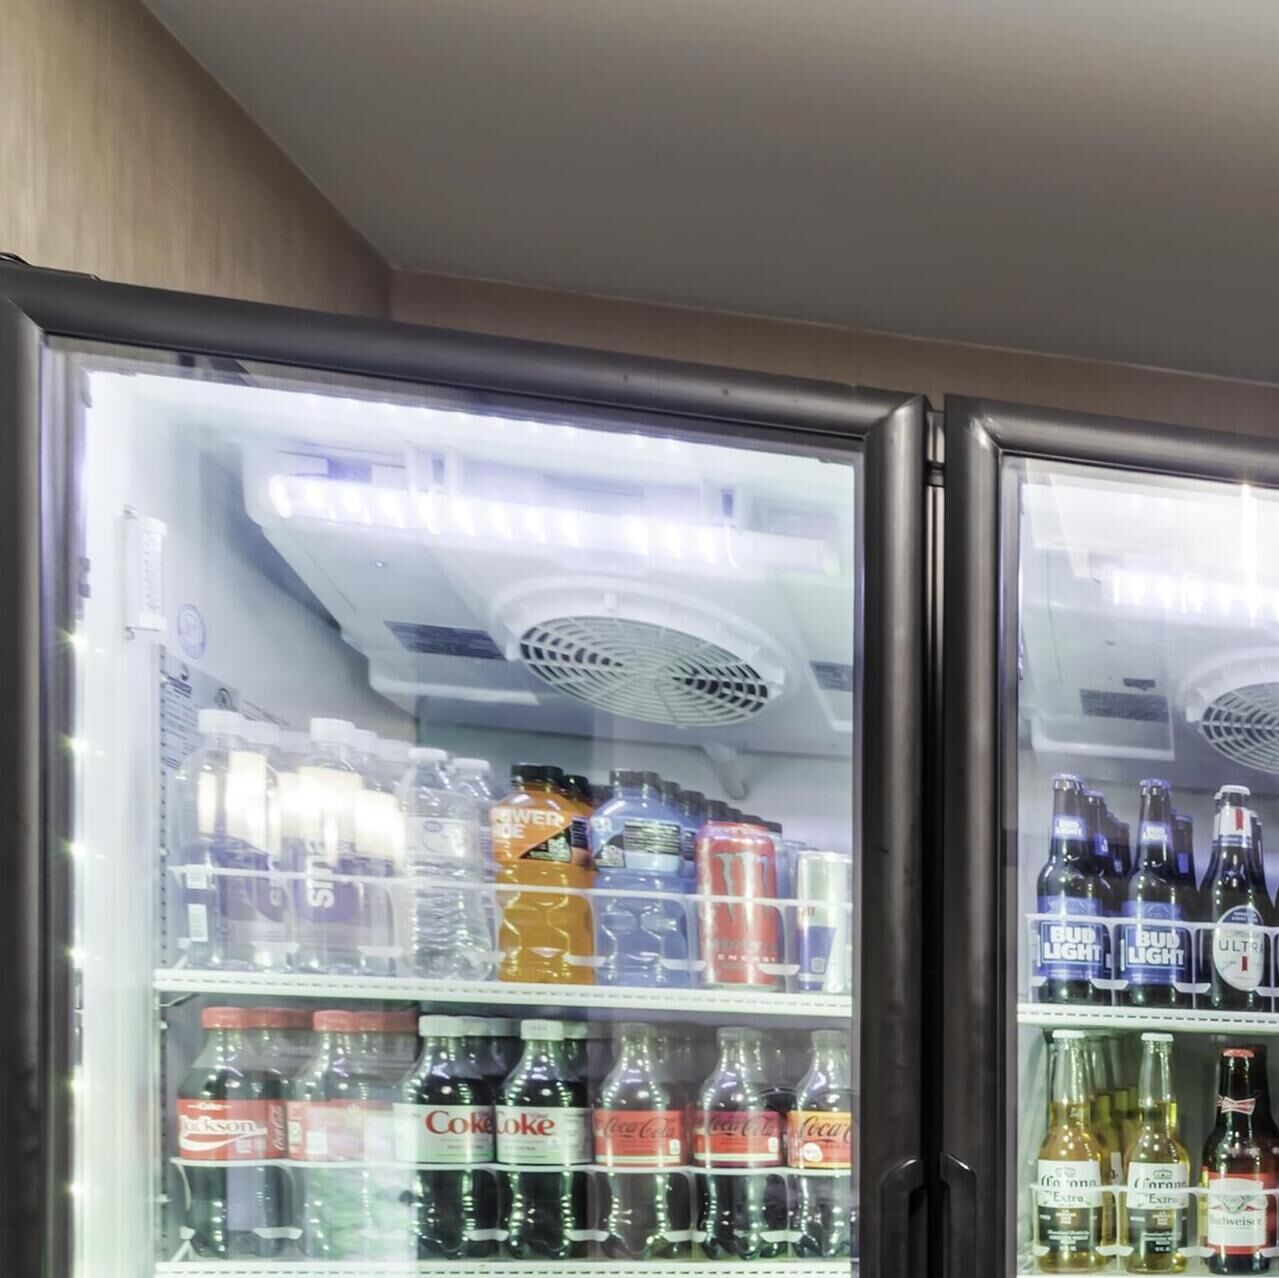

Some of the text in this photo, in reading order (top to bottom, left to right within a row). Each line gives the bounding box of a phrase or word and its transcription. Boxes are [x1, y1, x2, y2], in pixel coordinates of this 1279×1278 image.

[1050, 926, 1097, 944] BUD
[1135, 930, 1181, 950] BUD
[1043, 943, 1102, 962] LIGHT
[1128, 948, 1185, 966] LIGHT
[425, 1110, 494, 1136] Coke
[496, 1112, 556, 1137] Coke
[603, 1116, 678, 1140] Coca-Cola
[706, 1115, 777, 1138] Coca-Cola
